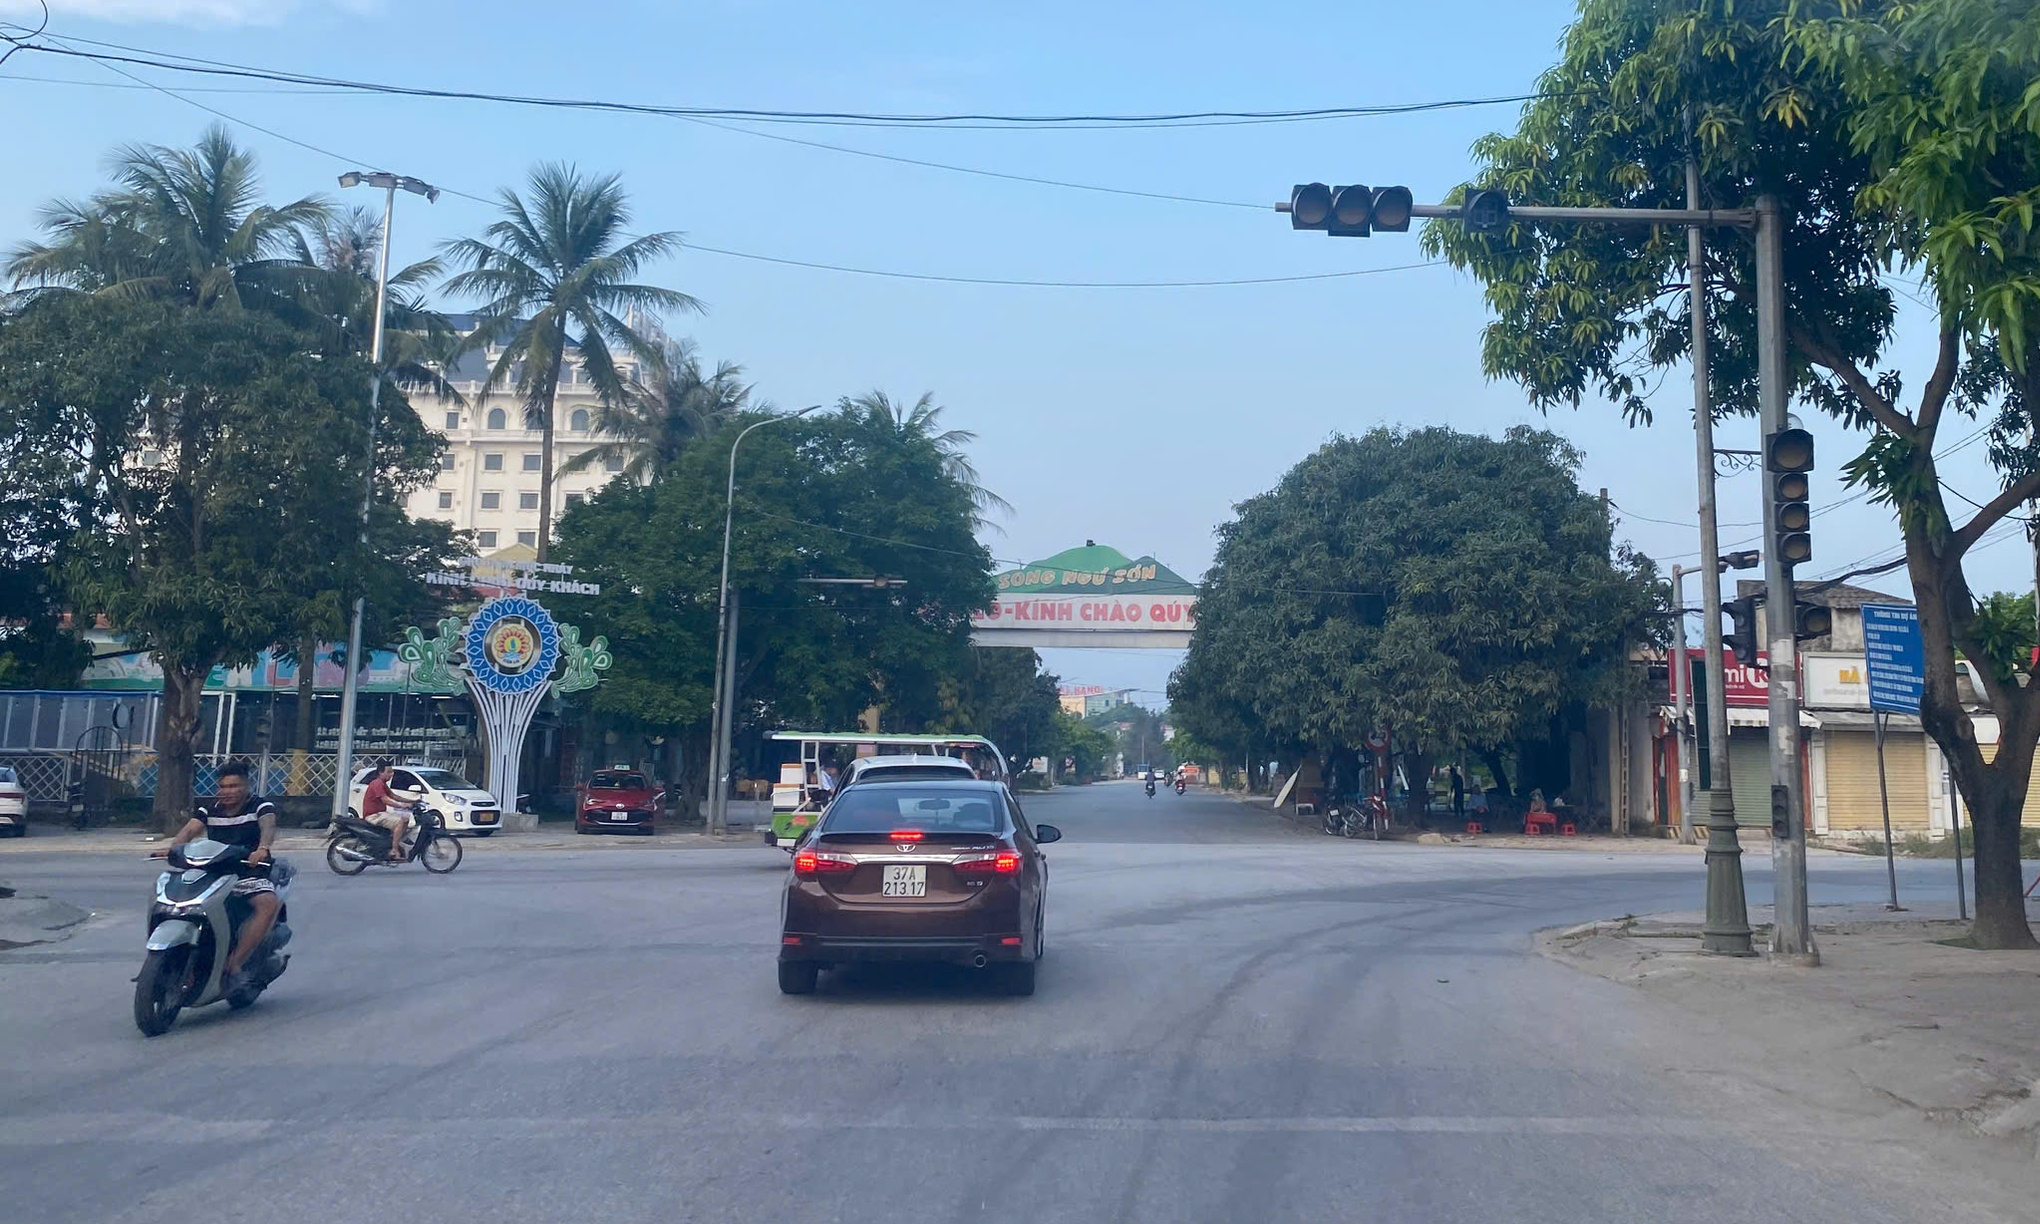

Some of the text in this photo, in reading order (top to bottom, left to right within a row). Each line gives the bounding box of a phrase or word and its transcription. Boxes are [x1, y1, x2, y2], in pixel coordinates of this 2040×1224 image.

[550, 579, 601, 596] KHÁCH
[998, 570, 1056, 590] SONG
[1080, 600, 1143, 622] CHÀO
[893, 867, 916, 881] 37A
[884, 882, 925, 896] 213.17
